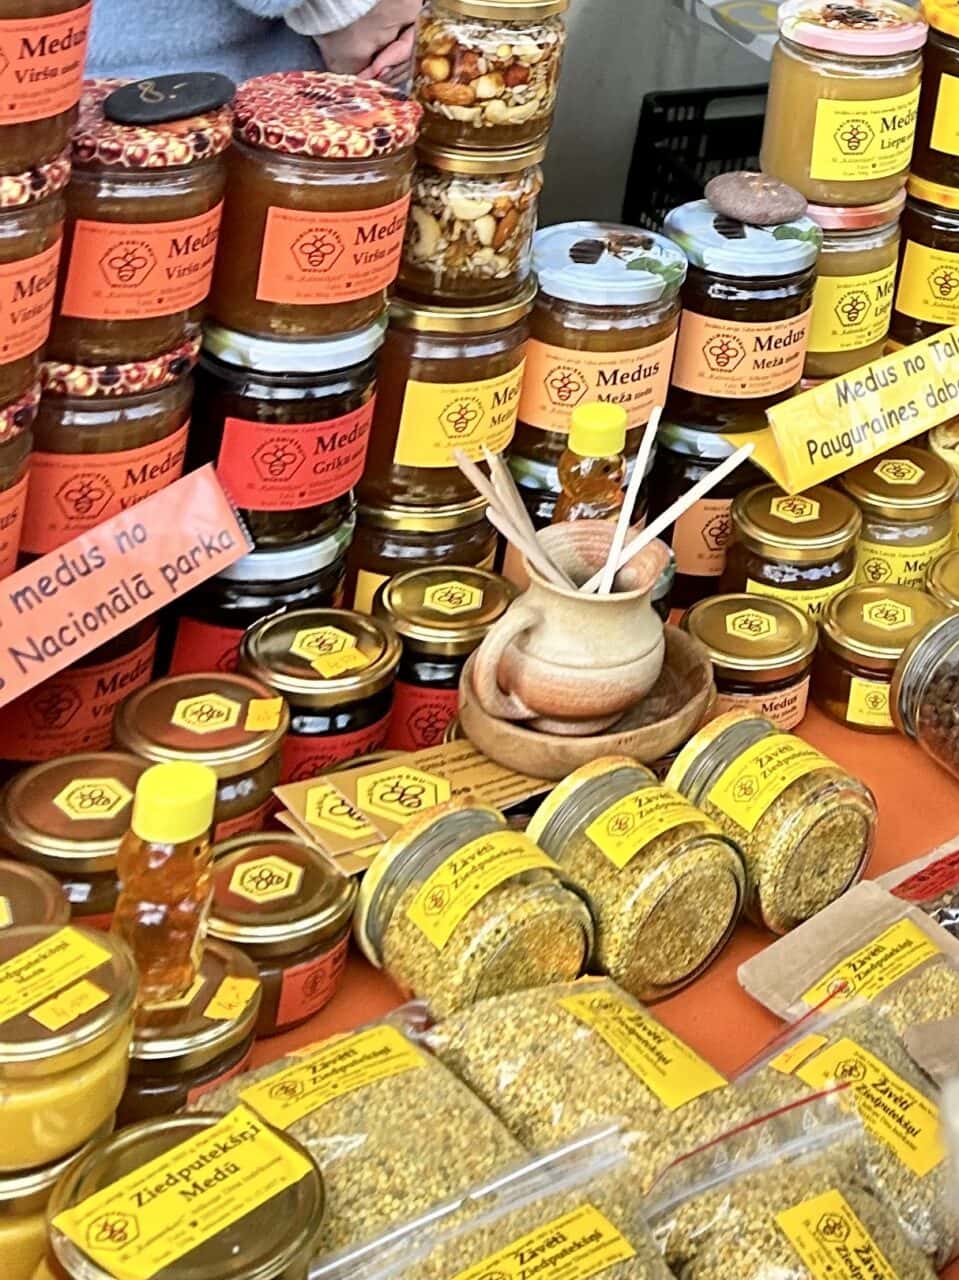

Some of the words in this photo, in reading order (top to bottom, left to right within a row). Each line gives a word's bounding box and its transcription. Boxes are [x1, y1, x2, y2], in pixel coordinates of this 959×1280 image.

[752, 327, 805, 354] Medus
[595, 360, 661, 388] Medus
[835, 364, 898, 408] Medus
[904, 352, 926, 375] no
[806, 400, 920, 465] Pauguraines
[9, 545, 107, 615] medus
[113, 522, 149, 555] no
[8, 573, 155, 675] Nacionālā
[160, 528, 237, 593] parka
[760, 695, 798, 714] Medus
[128, 1120, 262, 1209] Ziedputekšņi
[178, 1161, 242, 1203] Medū
